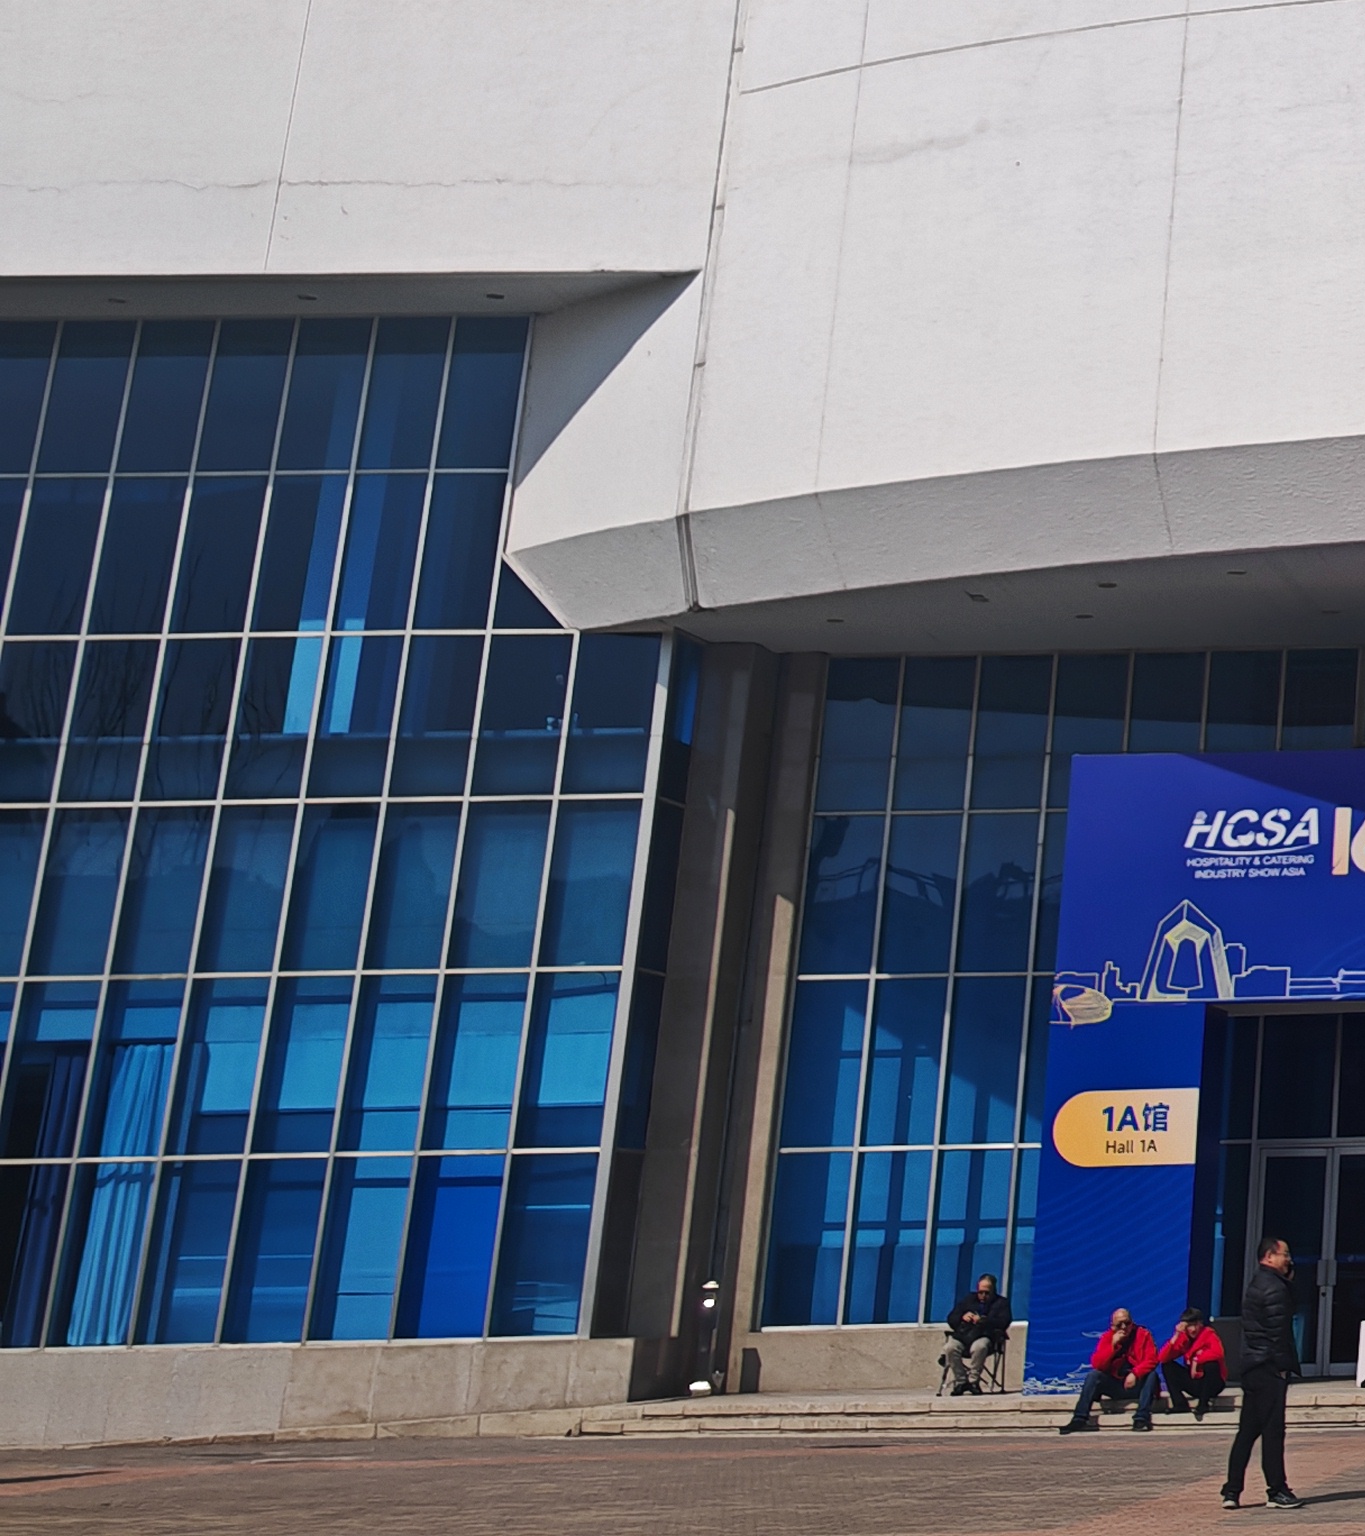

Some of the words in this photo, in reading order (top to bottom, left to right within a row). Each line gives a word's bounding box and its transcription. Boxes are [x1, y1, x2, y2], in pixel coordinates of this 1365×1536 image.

[1184, 808, 1319, 848] HCSA
[1187, 856, 1252, 868] HOSPITALITY
[1262, 854, 1315, 865] CATERING
[1195, 868, 1248, 880] INDUSTRY
[1249, 867, 1281, 878] SHOW
[1281, 866, 1306, 877] ASIA
[1101, 1102, 1171, 1133] 1A馆
[1105, 1139, 1134, 1154] Hall
[1139, 1139, 1158, 1154] 1A
